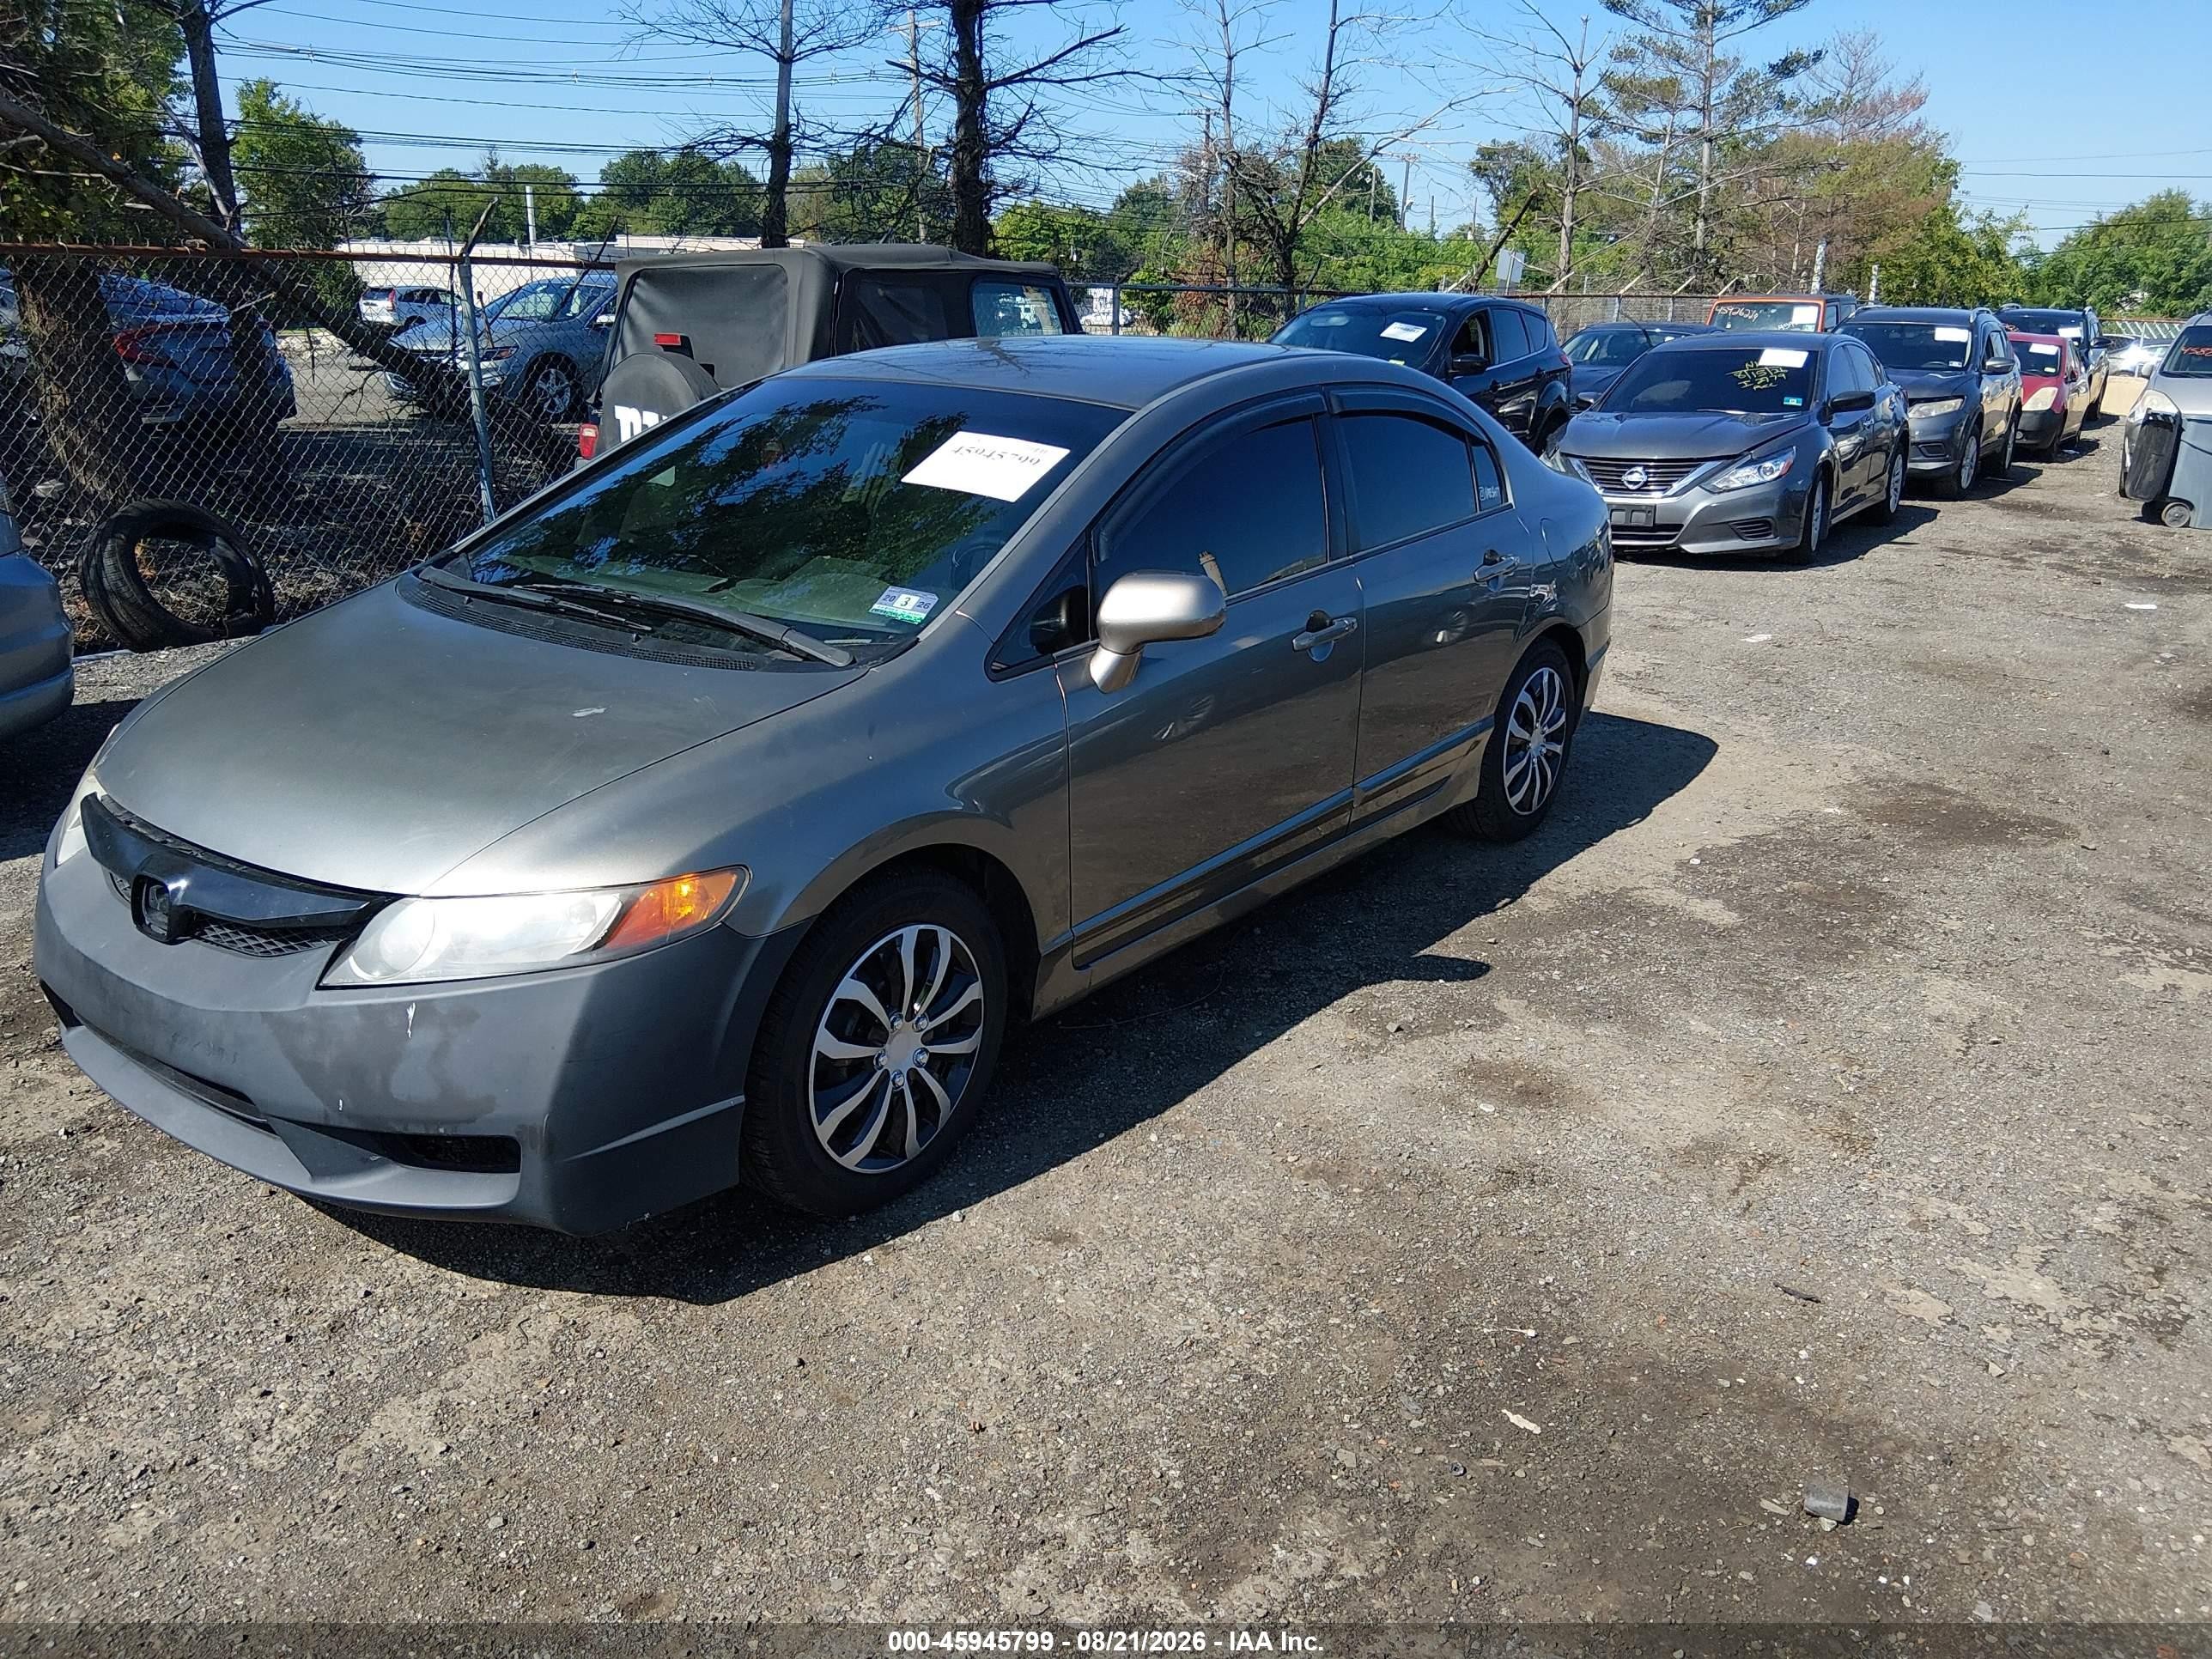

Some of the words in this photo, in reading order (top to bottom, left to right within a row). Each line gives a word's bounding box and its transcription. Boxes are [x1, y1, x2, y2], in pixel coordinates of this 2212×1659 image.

[882, 594, 896, 603] 20
[900, 597, 911, 607] 3
[916, 601, 932, 610] 26
